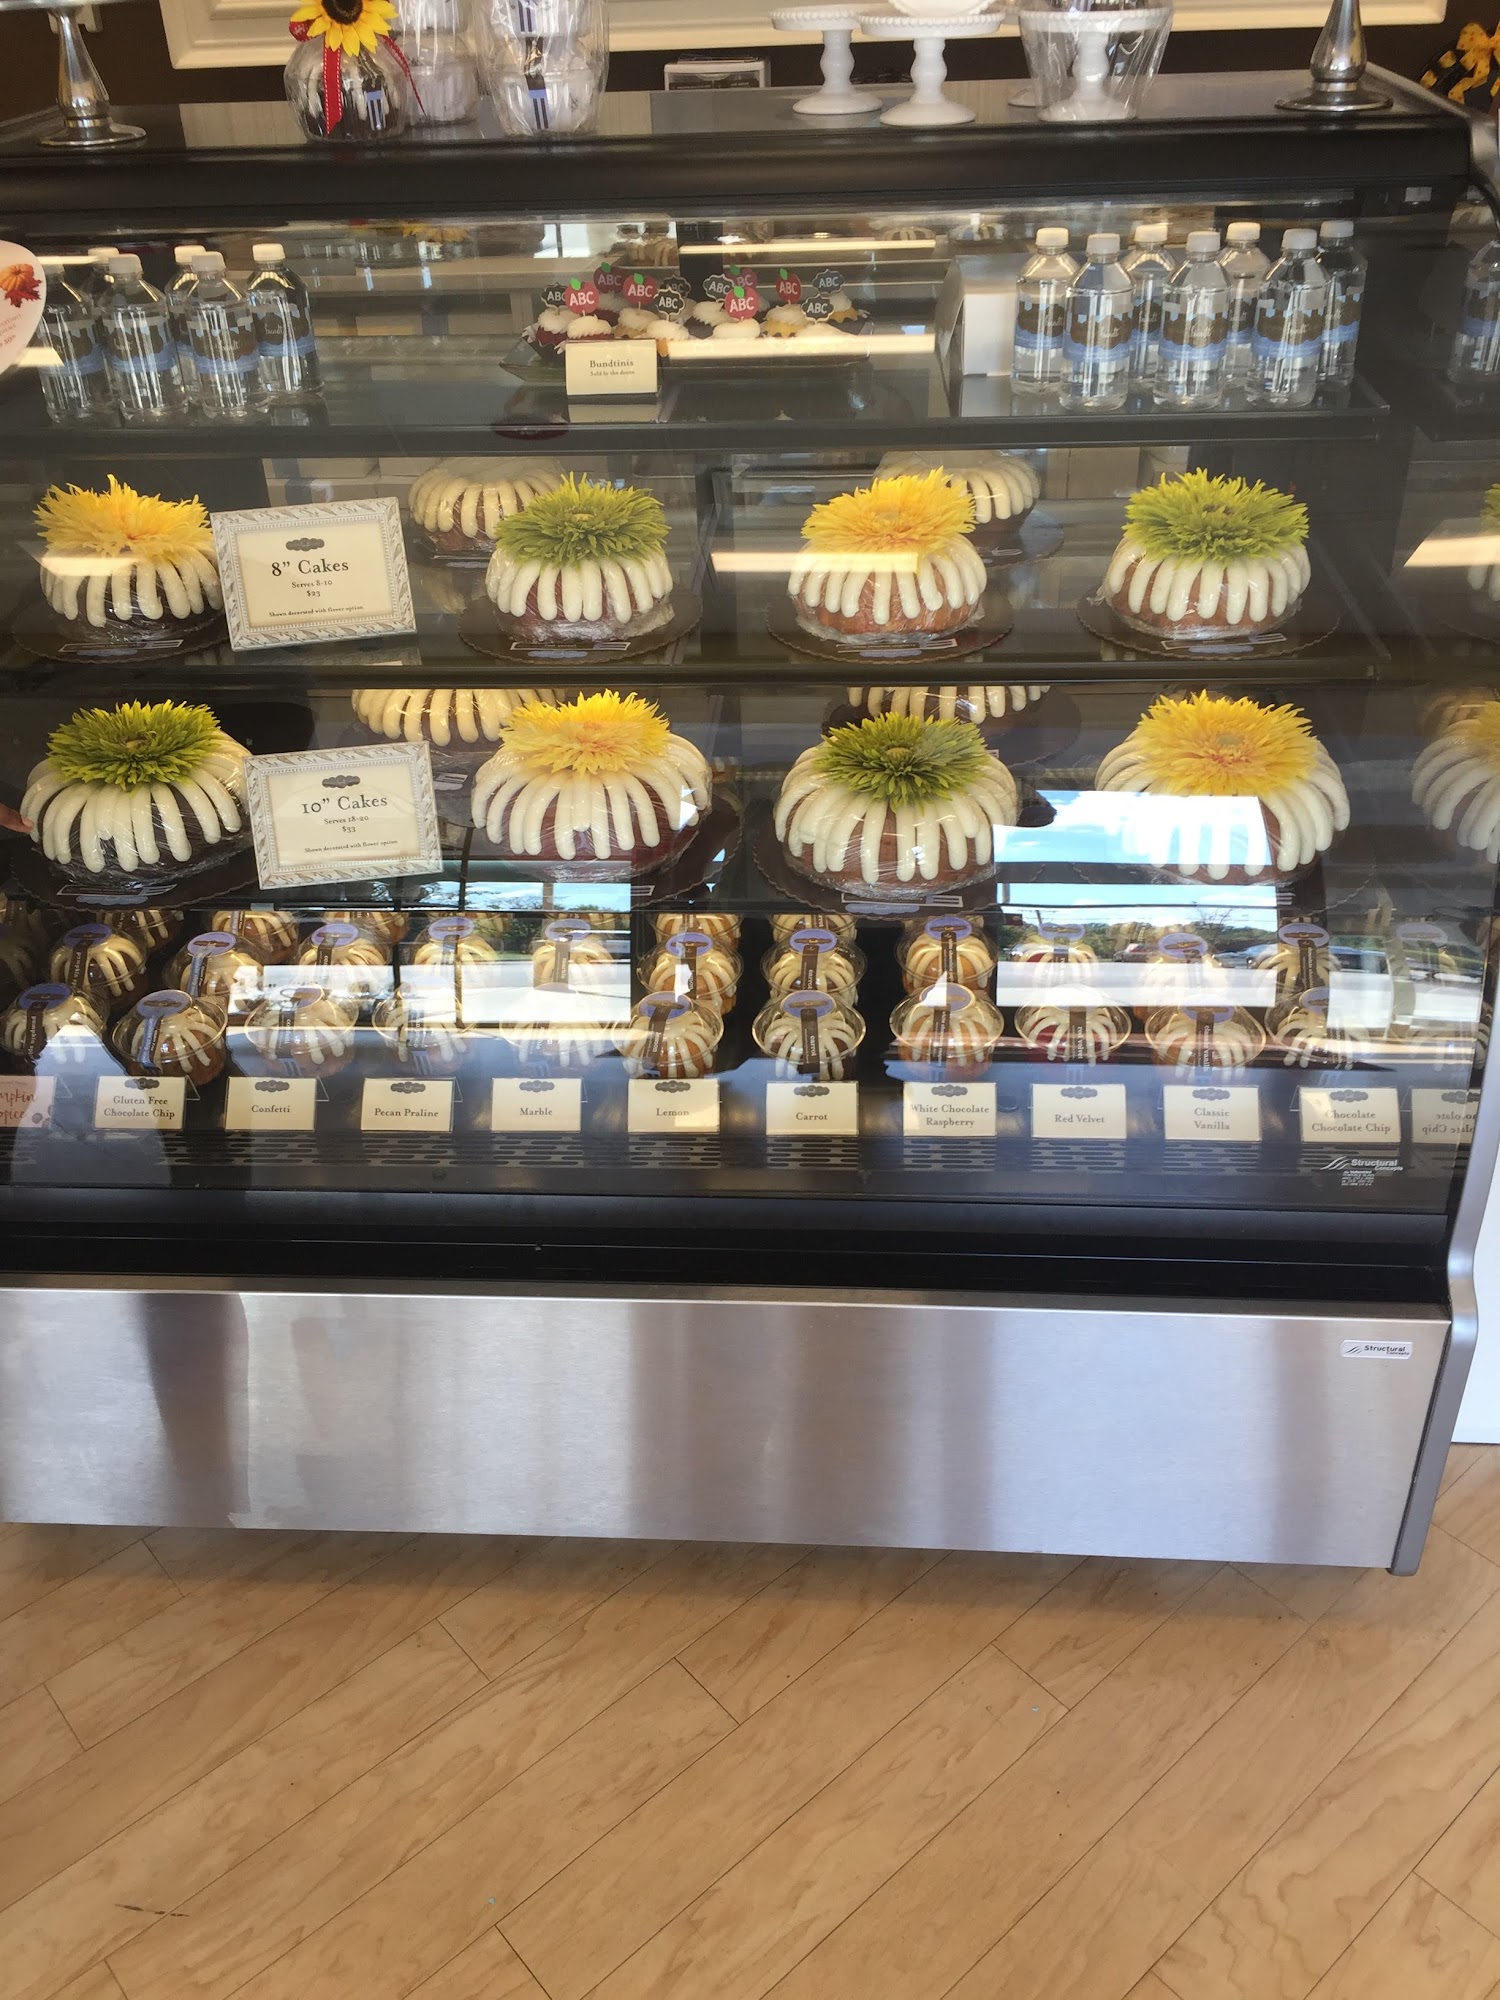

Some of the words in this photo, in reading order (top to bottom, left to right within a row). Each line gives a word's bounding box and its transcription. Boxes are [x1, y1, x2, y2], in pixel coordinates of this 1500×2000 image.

[598, 274, 622, 286] ABC
[819, 277, 839, 287] ABC
[628, 284, 653, 297] ABC
[779, 283, 798, 294] ABC
[570, 292, 594, 306] ABC
[659, 298, 678, 309] ABC
[730, 297, 754, 312] ABC
[807, 303, 828, 313] ABC
[590, 360, 634, 368] Bundtinis
[298, 559, 349, 574] Cakes
[338, 794, 388, 810] Cakes
[653, 1032, 662, 1052] lemon
[113, 1096, 144, 1104] Gluten
[148, 1096, 168, 1104] Free
[104, 1108, 149, 1117] Chocolate
[152, 1109, 175, 1119] Chip
[252, 1105, 290, 1113] Confetti
[374, 1108, 401, 1116] Pecan
[404, 1108, 439, 1117] Praline
[520, 1108, 553, 1116] Marble
[656, 1108, 690, 1116] Lemon
[911, 1105, 938, 1113] White
[942, 1105, 990, 1113] Chocolate
[1194, 1108, 1230, 1117] Classic
[1326, 1110, 1376, 1118] Chocolate
[796, 1112, 828, 1120] Carrot
[1054, 1114, 1073, 1123] Red
[1076, 1114, 1105, 1123] Velvet
[926, 1118, 975, 1128] Raspberry
[1194, 1121, 1230, 1130] Vanilla
[1312, 1123, 1362, 1131] Chocolate
[1366, 1124, 1390, 1134] Chip
